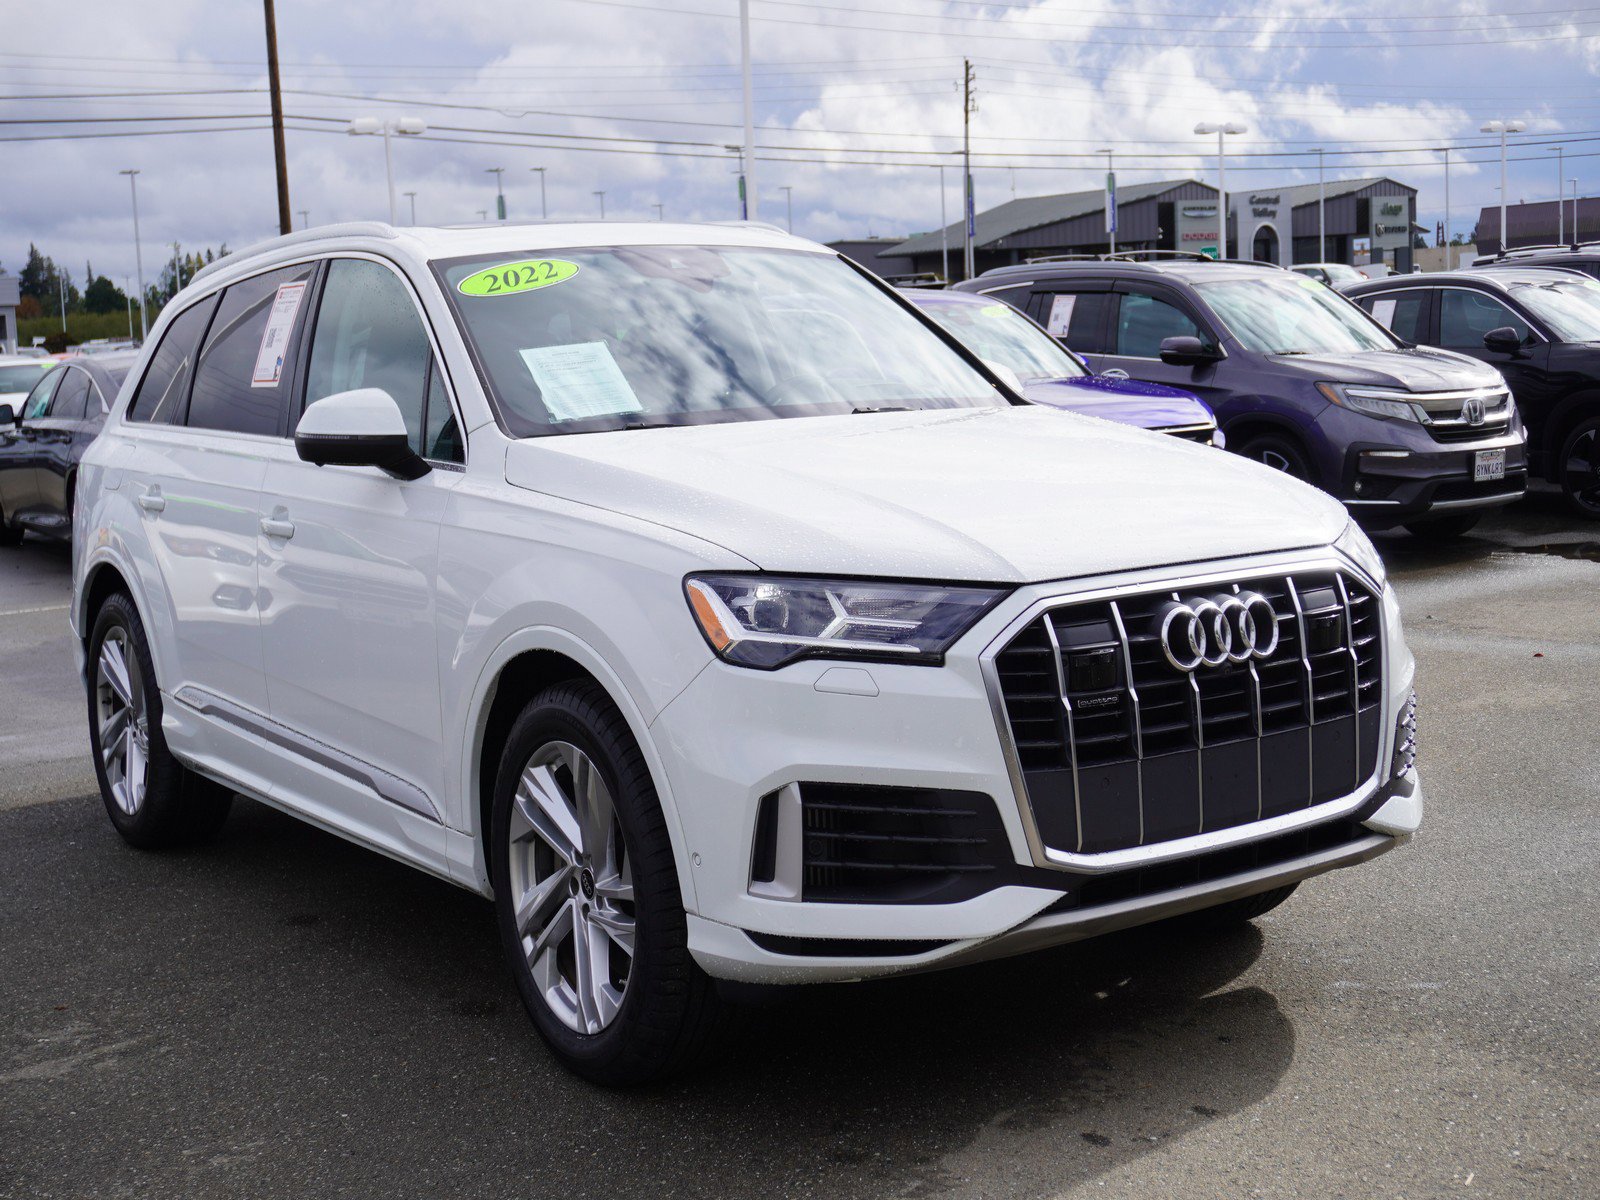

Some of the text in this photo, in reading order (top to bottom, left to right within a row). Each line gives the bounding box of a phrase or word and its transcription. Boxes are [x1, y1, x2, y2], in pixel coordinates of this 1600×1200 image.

[1249, 195, 1280, 205] Central
[1252, 207, 1277, 219] Valley
[1183, 232, 1218, 241] DODGE
[483, 262, 558, 293] 2022
[1476, 461, 1503, 477] 8YNK483
[1079, 696, 1118, 707] quattro
